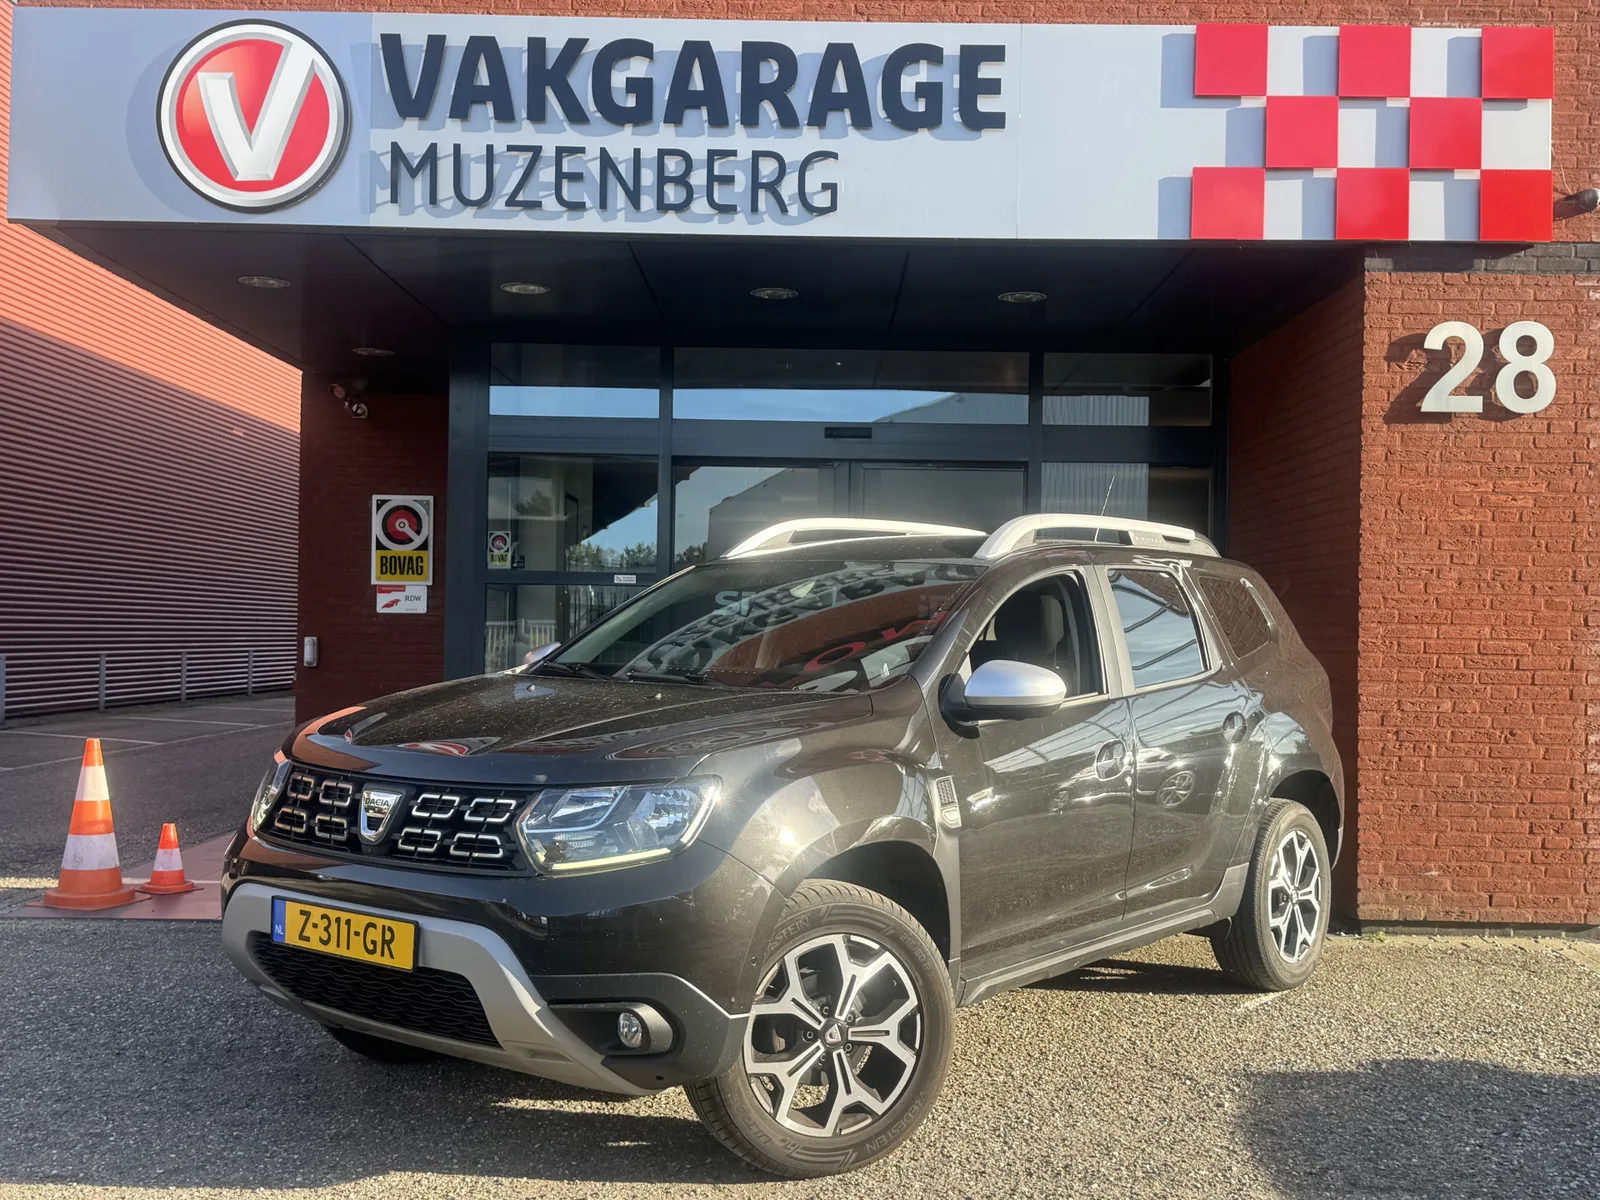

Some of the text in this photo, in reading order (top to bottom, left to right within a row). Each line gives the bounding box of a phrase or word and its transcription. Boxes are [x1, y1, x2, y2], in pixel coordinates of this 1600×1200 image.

[380, 33, 1006, 131] VAKGARAGE
[389, 141, 839, 214] MUZENBERG
[1420, 320, 1557, 414] 28
[380, 555, 424, 576] BOVAG
[404, 594, 422, 602] RDW
[364, 797, 390, 807] DACIA
[273, 924, 284, 935] NL
[298, 909, 395, 960] Z-311-GR
